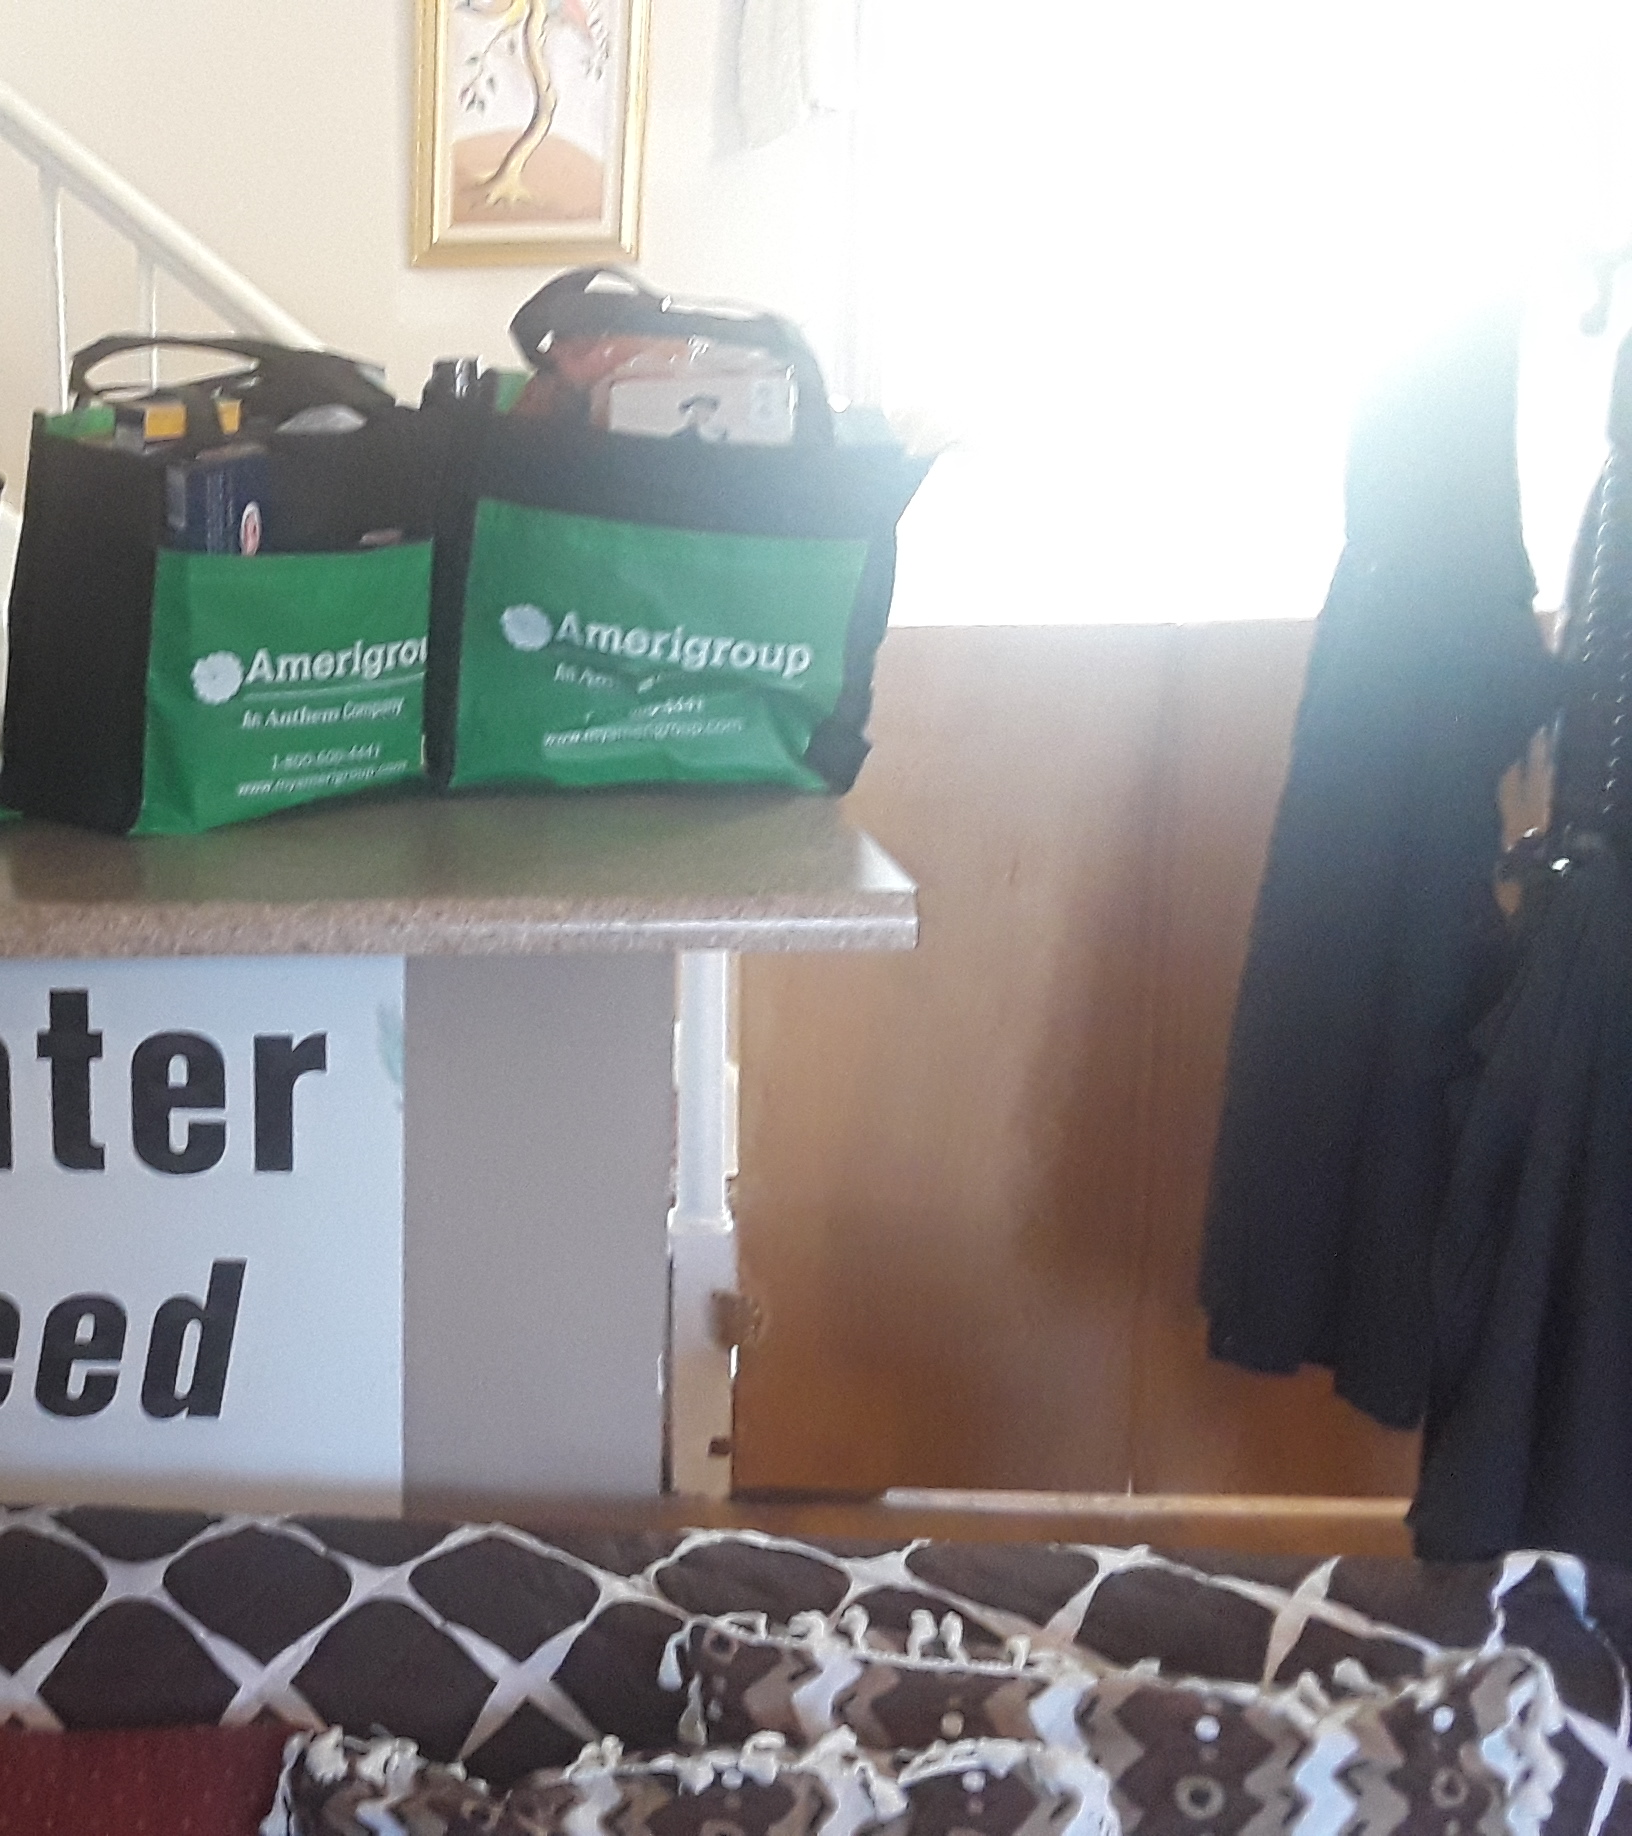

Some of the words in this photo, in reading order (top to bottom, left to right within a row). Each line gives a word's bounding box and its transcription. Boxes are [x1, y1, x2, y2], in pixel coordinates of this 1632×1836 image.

[555, 611, 811, 678] Amerigroup
[265, 705, 342, 727] Anthem
[342, 697, 405, 720] Company
